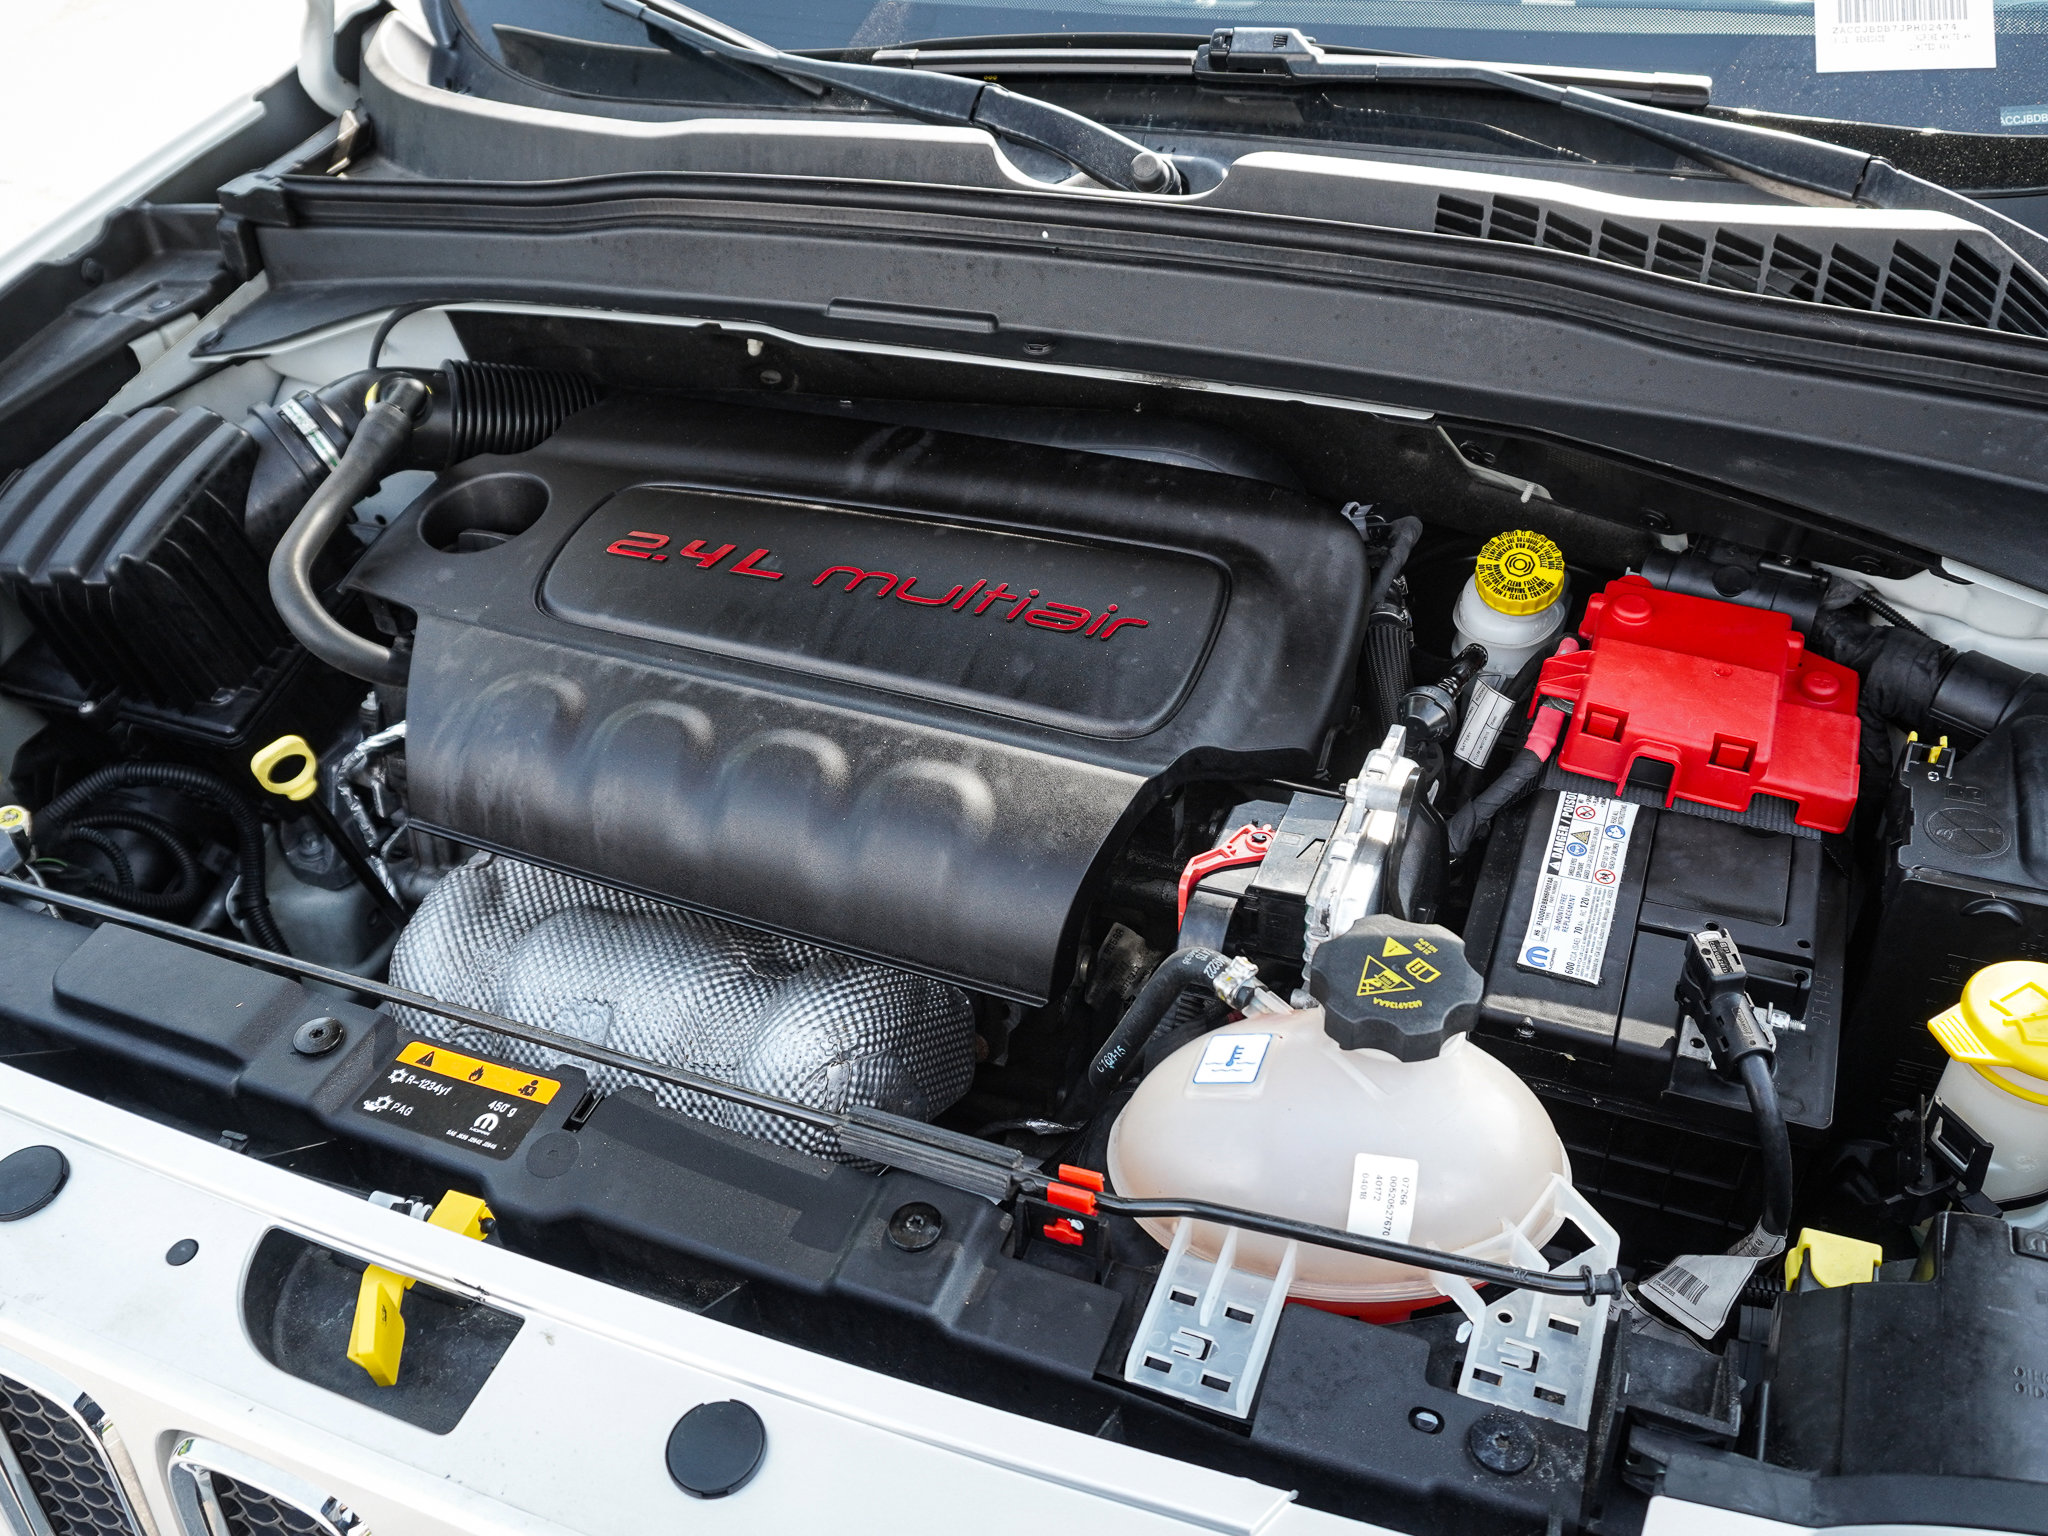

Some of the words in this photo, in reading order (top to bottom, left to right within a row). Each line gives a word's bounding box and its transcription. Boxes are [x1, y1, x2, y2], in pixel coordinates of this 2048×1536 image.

[812, 564, 1150, 640] multiair
[1553, 824, 1570, 857] DANGER
[1562, 894, 1576, 932] REPLACEMENT
[1565, 961, 1575, 975] 600
[1580, 896, 1590, 909] 120
[405, 1074, 454, 1097] R-1234yf
[390, 1102, 415, 1117] PAG
[1373, 1174, 1383, 1201] 40172
[1400, 1176, 1410, 1205] 07266
[1382, 1175, 1398, 1236] 00520527670
